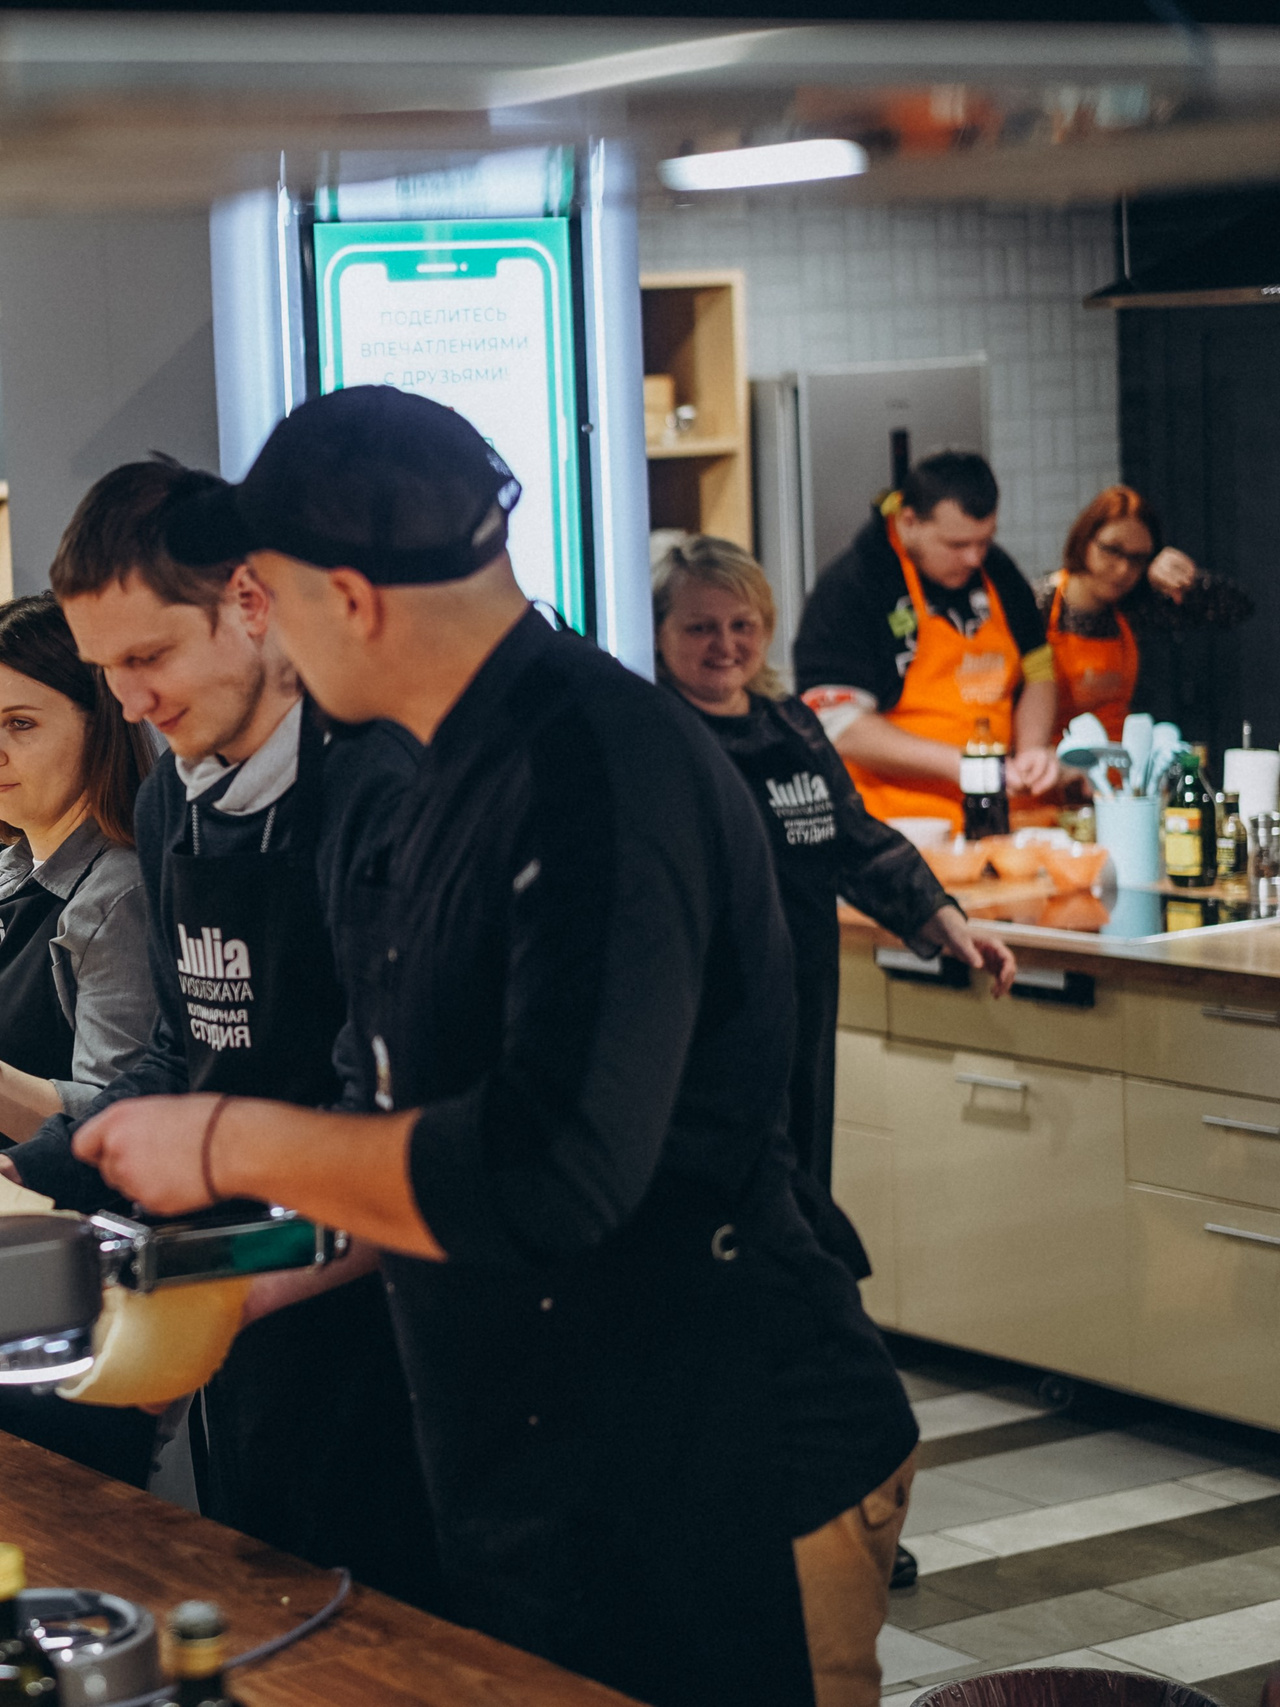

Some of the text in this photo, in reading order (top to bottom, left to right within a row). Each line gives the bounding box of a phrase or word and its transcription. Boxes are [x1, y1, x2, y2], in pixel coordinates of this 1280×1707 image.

[380, 307, 508, 327] ПОДЕЛИТЕСЬ
[360, 335, 530, 358] ВПЕЧАТЛЕНИЯМИ
[177, 923, 252, 980] Julia
[190, 1018, 252, 1052] СТУДИЯ
